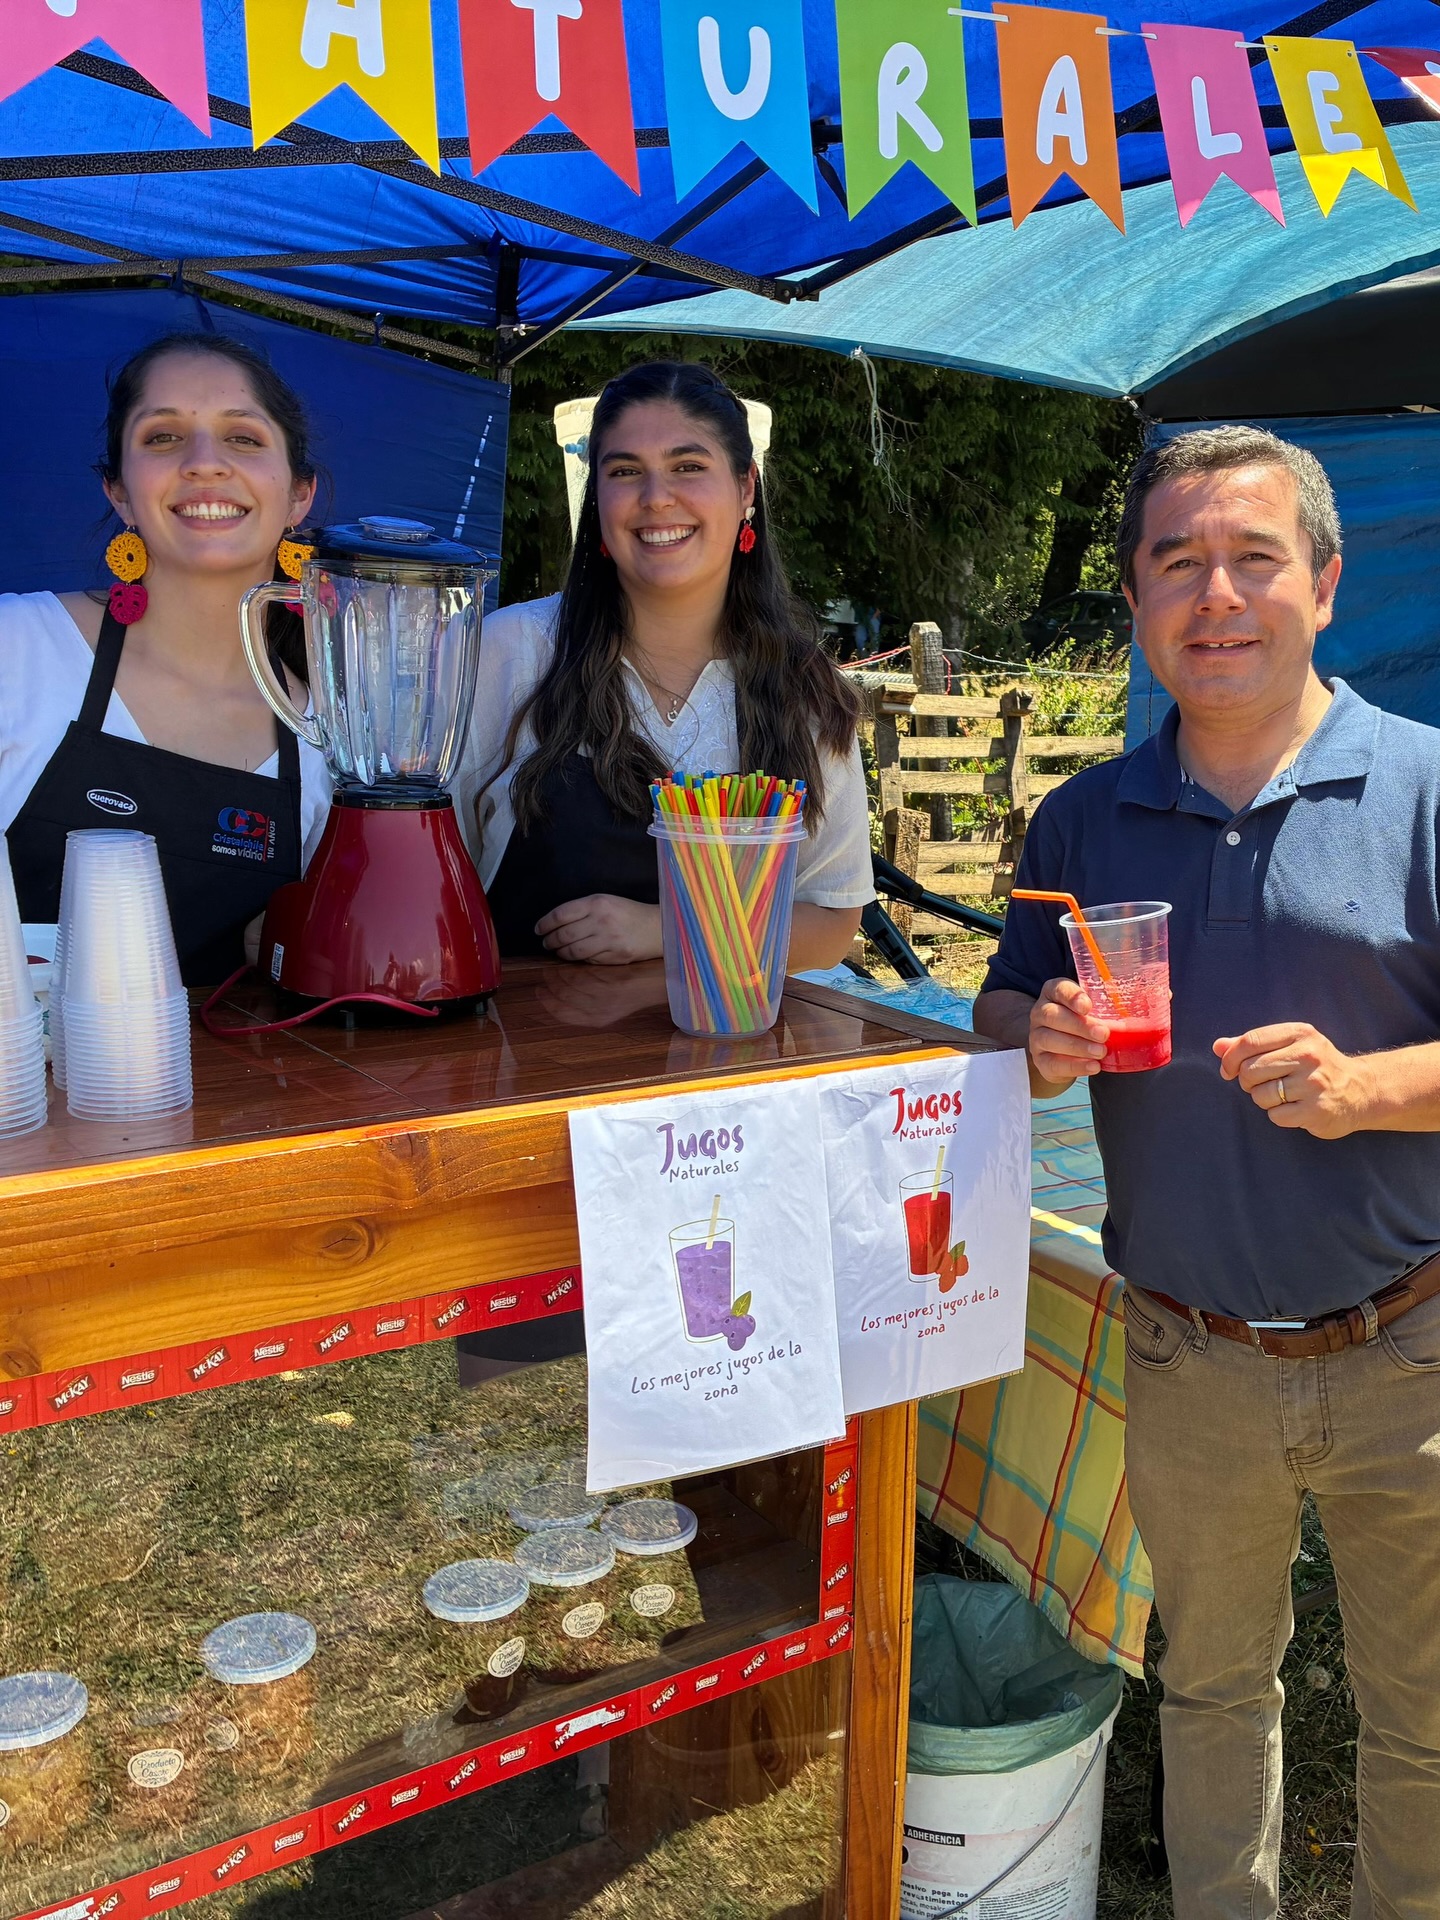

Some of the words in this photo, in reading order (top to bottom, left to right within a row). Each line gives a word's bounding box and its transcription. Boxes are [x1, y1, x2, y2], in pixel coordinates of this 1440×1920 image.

[90, 793, 133, 811] cuerovaca
[212, 844, 237, 856] somos
[213, 833, 264, 851] Cristalchile
[899, 1122, 958, 1142] Naturales
[669, 1160, 740, 1183] Naturales
[861, 1316, 881, 1332] Los
[884, 1304, 935, 1330] mejores
[938, 1294, 969, 1316] jugos
[971, 1289, 986, 1303] de
[989, 1286, 1000, 1299] la
[917, 1323, 946, 1338] zona
[631, 1375, 656, 1395] Los
[660, 1361, 723, 1391] mejores
[726, 1352, 764, 1380] jugos
[768, 1345, 786, 1361] de
[788, 1340, 803, 1355] la
[704, 1383, 739, 1401] zona
[907, 1828, 962, 1846] ADHERENCIA
[932, 1889, 951, 1897] pega
